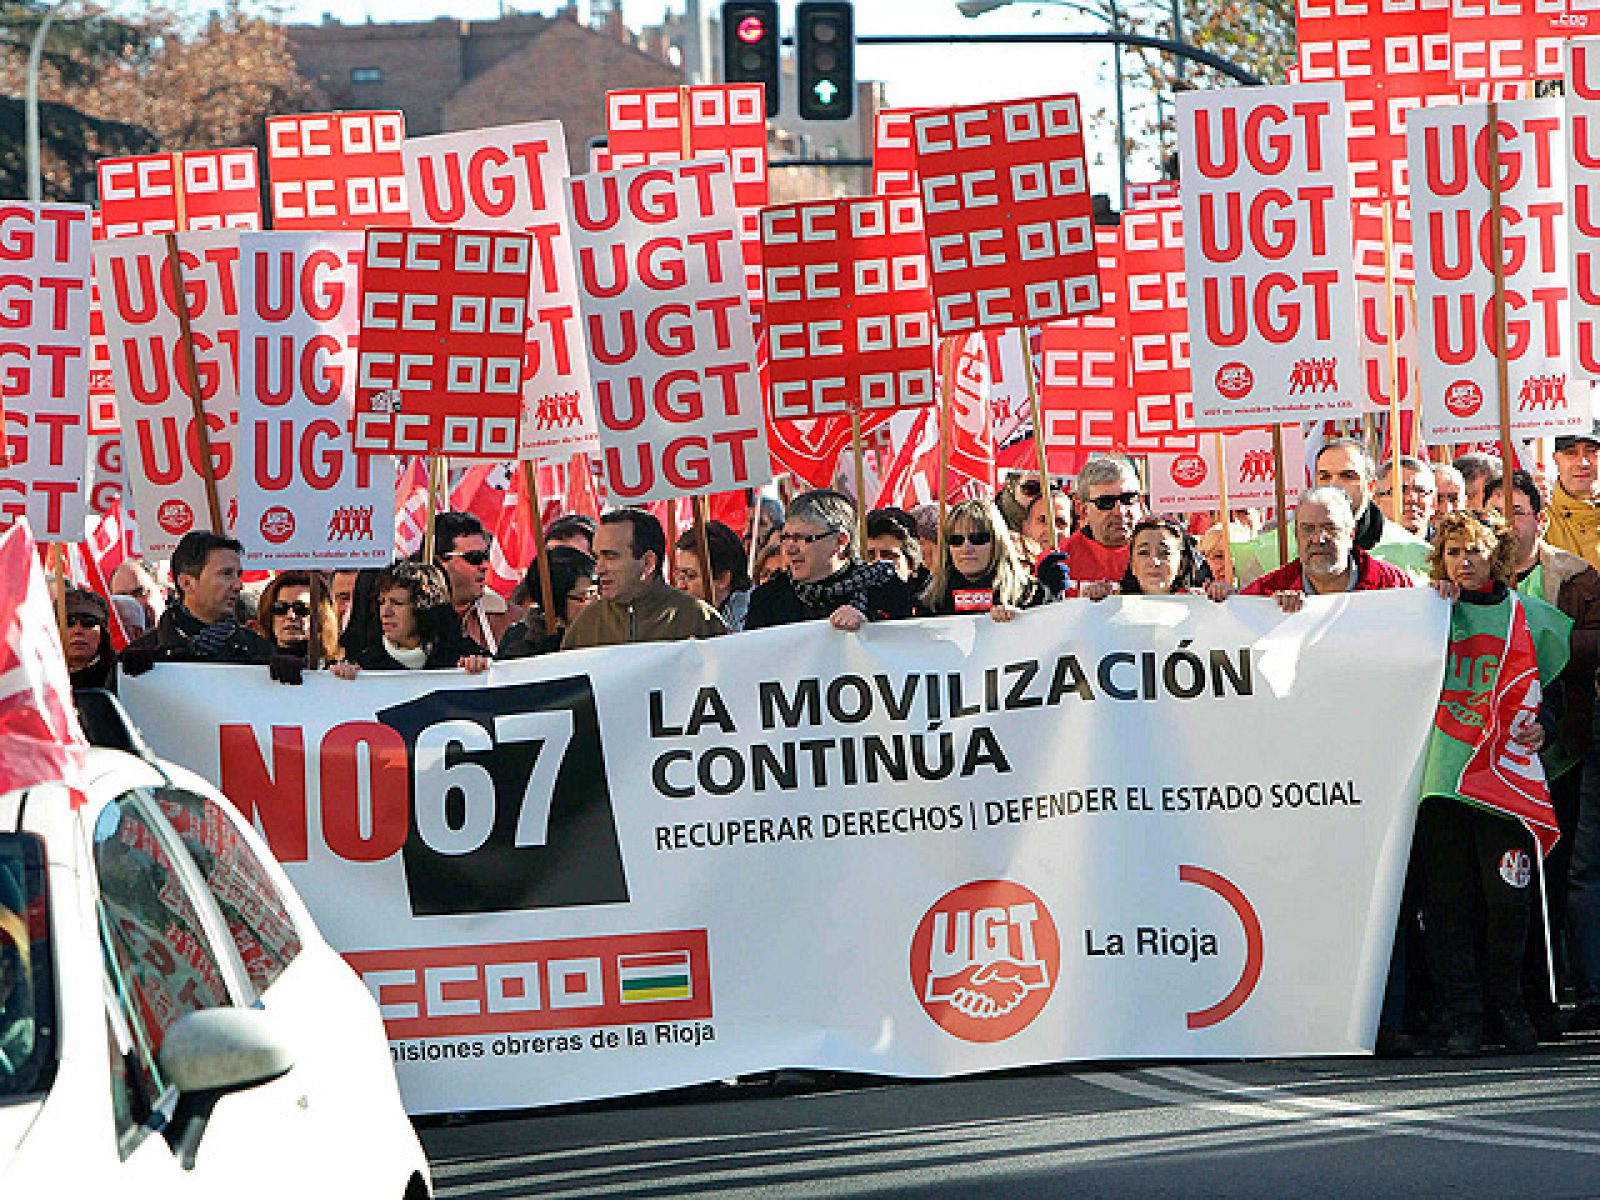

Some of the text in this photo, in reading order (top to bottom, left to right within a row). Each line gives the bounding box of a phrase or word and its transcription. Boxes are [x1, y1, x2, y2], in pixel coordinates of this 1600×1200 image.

[1454, 36, 1566, 80] CCO
[1195, 102, 1330, 178] UGT
[1424, 118, 1560, 196] UGT
[417, 140, 548, 224] UGT
[570, 163, 724, 232] UGT
[0, 208, 86, 262] GT
[1199, 186, 1333, 263] UGT
[1429, 203, 1563, 281] UGT
[110, 247, 238, 324] UGT
[580, 230, 732, 297] UGT
[0, 276, 83, 330] GT
[589, 296, 741, 364] UGT
[1203, 270, 1338, 347] UGT
[1433, 288, 1567, 365] UGT
[0, 343, 80, 398] GT
[597, 362, 750, 430] UGT
[0, 412, 80, 467] GT
[135, 411, 237, 485] UG
[605, 429, 757, 498] UGT
[0, 481, 78, 533] GT
[650, 640, 1254, 738] LA MOVILIZACIÓN
[1450, 652, 1498, 690] UG
[652, 721, 1012, 798] CONTINÚA
[656, 780, 1362, 850] RECUPERAR DERECHOS DEFENDER EL ESTADO SOCIAL
[930, 902, 1038, 976] UGT
[1084, 926, 1218, 962] La Rioja
[362, 956, 603, 1019] CCOO
[492, 1032, 582, 1056] obreras
[590, 1029, 618, 1050] de
[626, 1026, 648, 1047] la
[656, 1022, 715, 1047] Rioja
